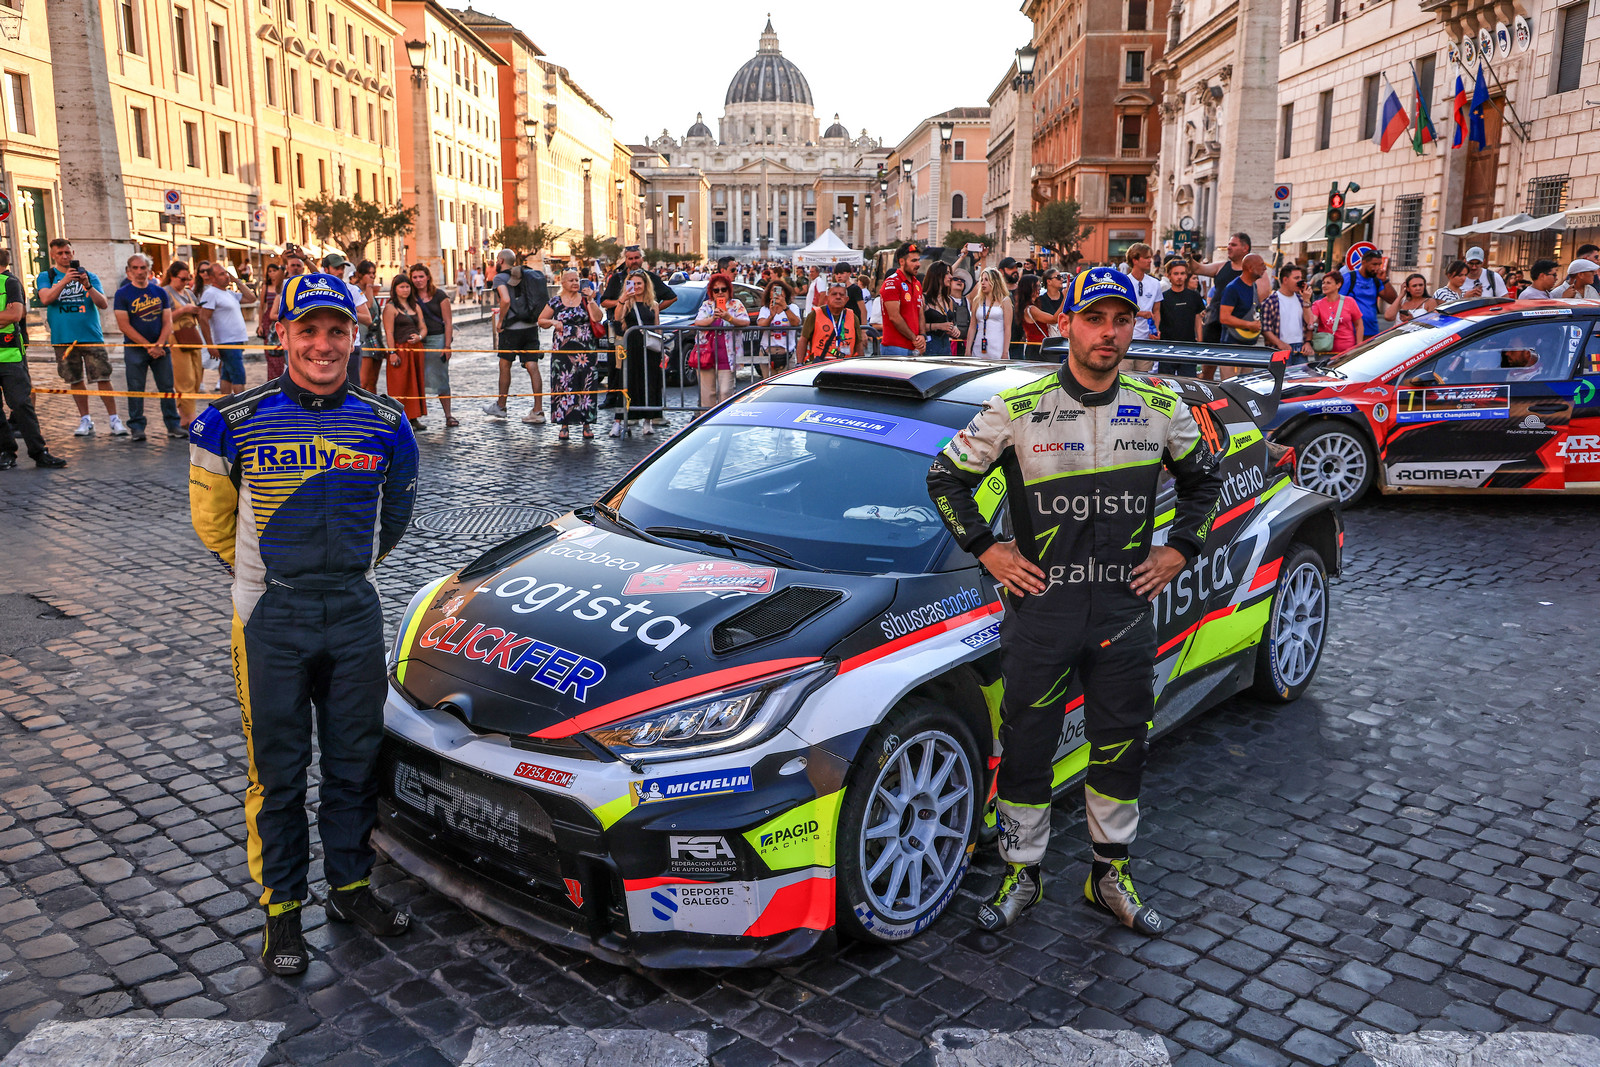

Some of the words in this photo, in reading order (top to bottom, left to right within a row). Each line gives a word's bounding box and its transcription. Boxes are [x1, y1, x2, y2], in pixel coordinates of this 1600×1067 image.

[296, 289, 346, 301] MICHELIN
[1083, 282, 1128, 296] MICHELIN
[1405, 353, 1425, 368] RALLY
[1425, 336, 1453, 356] ACADEMY
[1012, 400, 1032, 412] OMP
[1151, 397, 1172, 410] OMP
[228, 406, 251, 421] OMP
[377, 408, 397, 423] OMP
[1444, 411, 1481, 419] Championship
[822, 415, 886, 431] MICHELIN
[1033, 442, 1085, 453] CLICKFER
[1113, 438, 1159, 451] Arteixo
[257, 443, 383, 475] Rallycar
[1396, 468, 1485, 480] ROMBAT
[1034, 488, 1147, 521] logista
[697, 563, 714, 571] 34
[880, 586, 982, 640] sibuscascoche
[419, 616, 607, 703] CLICKFER
[516, 763, 526, 774] S
[523, 765, 548, 780] 7354
[547, 770, 571, 785] BCM
[666, 774, 750, 795] MICHELIN
[774, 819, 819, 844] PAGID
[760, 833, 821, 855] RACING
[681, 887, 734, 897] DEPORTE
[682, 896, 729, 906] GALEGO
[918, 869, 964, 931] MICHELIN
[273, 955, 300, 968] OMP
